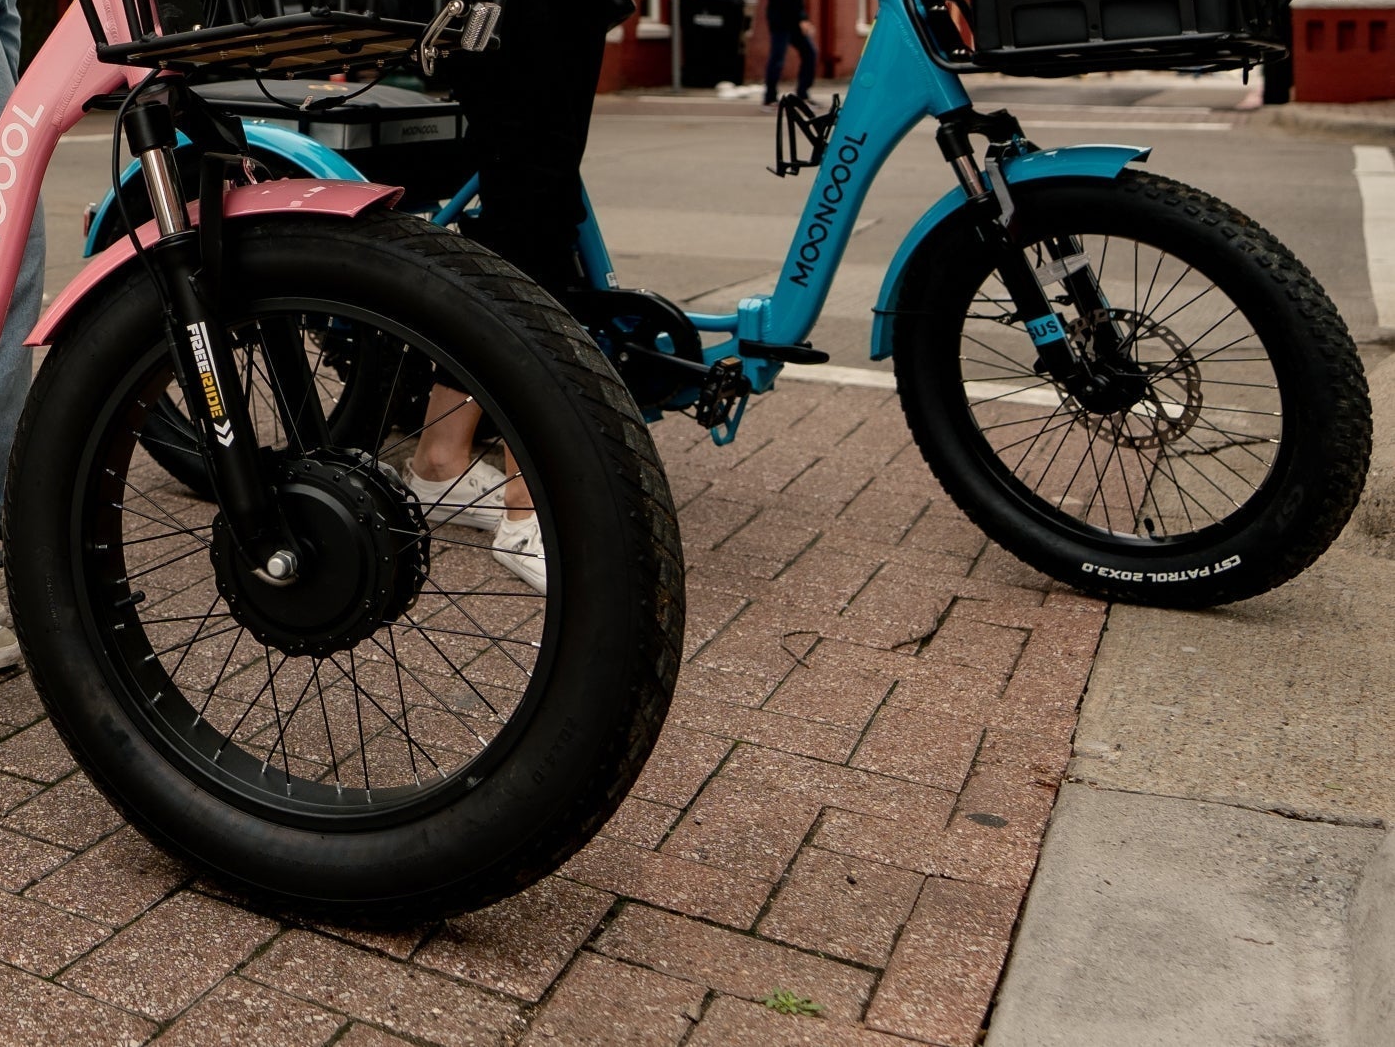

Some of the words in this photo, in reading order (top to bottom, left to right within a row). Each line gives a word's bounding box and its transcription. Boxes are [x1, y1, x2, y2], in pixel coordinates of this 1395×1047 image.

[789, 131, 868, 288] MOONCOOL
[186, 322, 223, 419] FREERIDE
[1147, 566, 1211, 582] PATROL
[1213, 554, 1242, 574] CST
